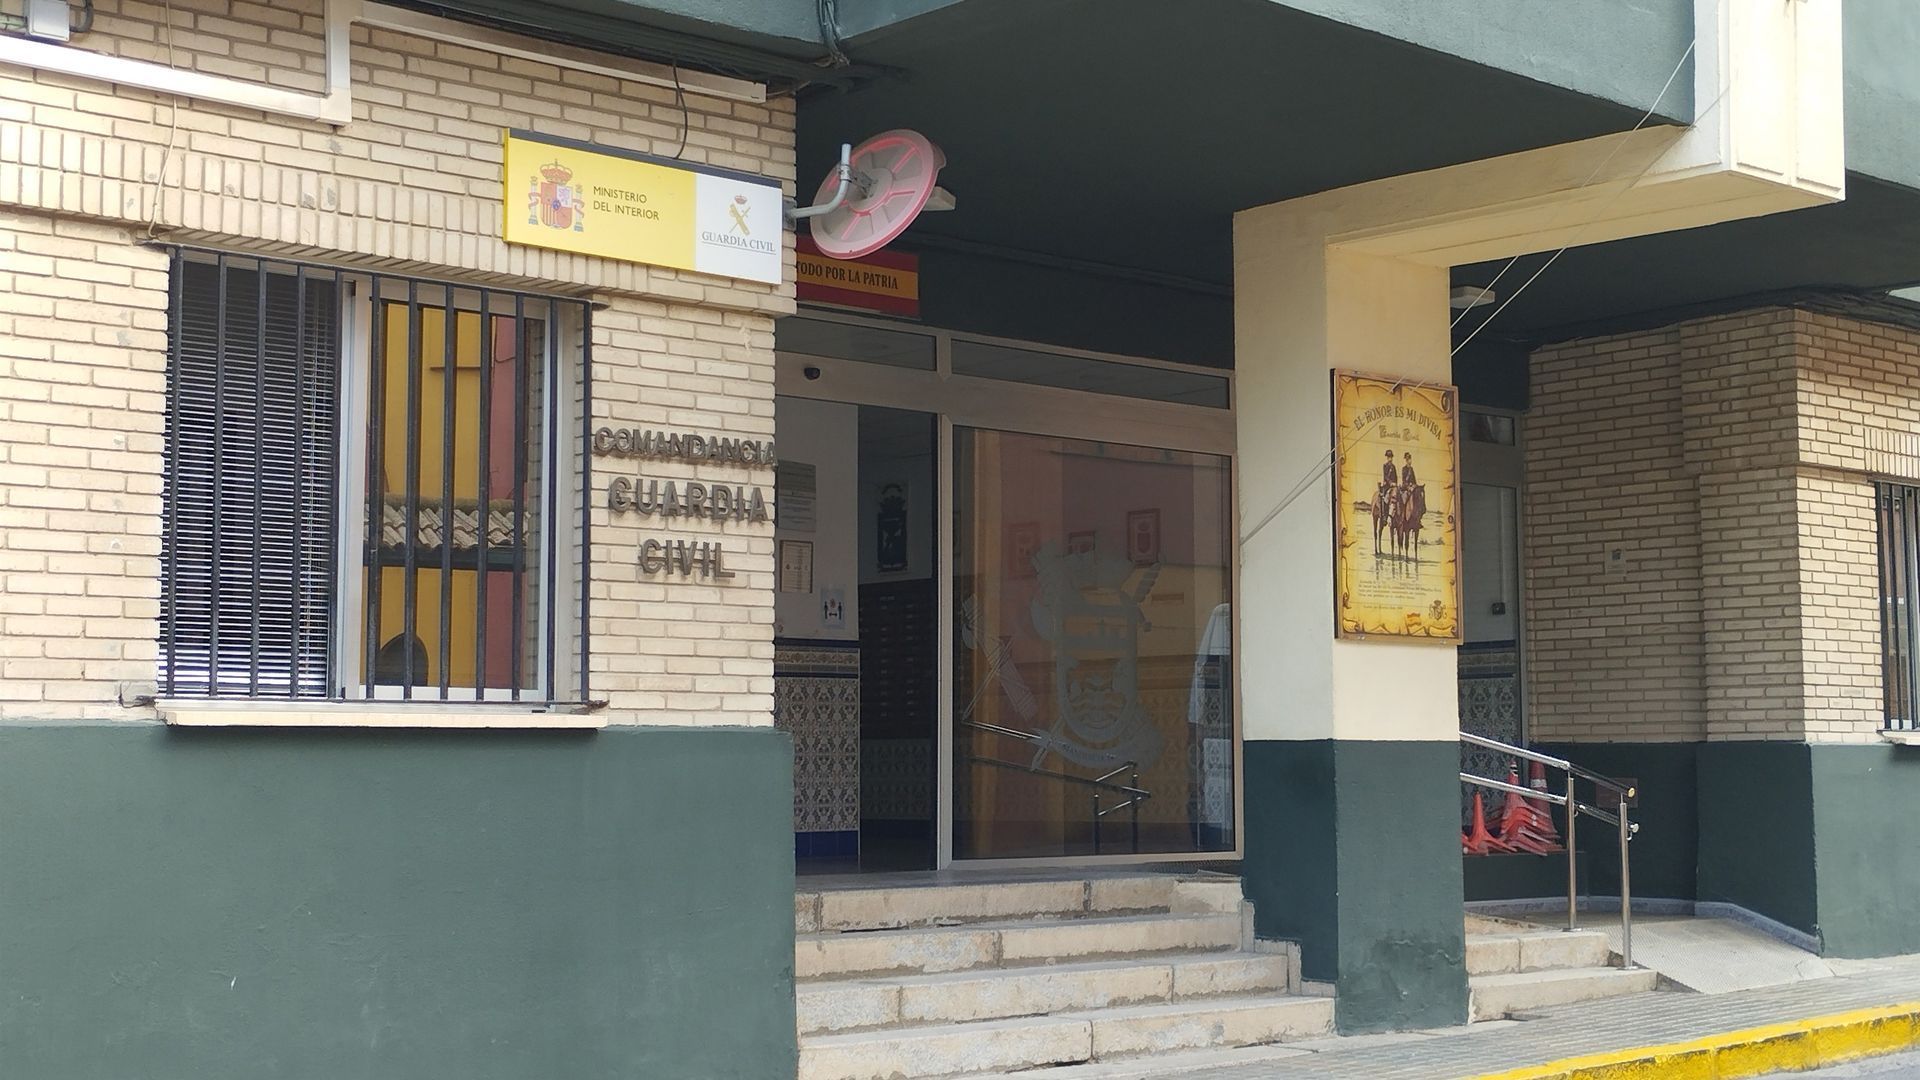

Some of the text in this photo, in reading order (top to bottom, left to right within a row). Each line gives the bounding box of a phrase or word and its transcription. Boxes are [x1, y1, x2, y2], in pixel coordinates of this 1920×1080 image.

[593, 186, 647, 204] MINISTERIO
[593, 200, 660, 221] DEL INTERIOR
[702, 231, 775, 252] GUARDIA CIVIL
[825, 266, 846, 280] POR
[848, 269, 861, 283] LA
[863, 272, 899, 290] PATRIA
[1353, 415, 1366, 431] EL
[1364, 405, 1393, 423] HONOR
[1394, 406, 1405, 418] ES
[1406, 408, 1417, 422] MI
[1418, 413, 1442, 440] DIVISA
[594, 427, 777, 465] COMANDANCIA
[608, 476, 769, 522] GUARDIA
[639, 538, 736, 579] CIVIL
